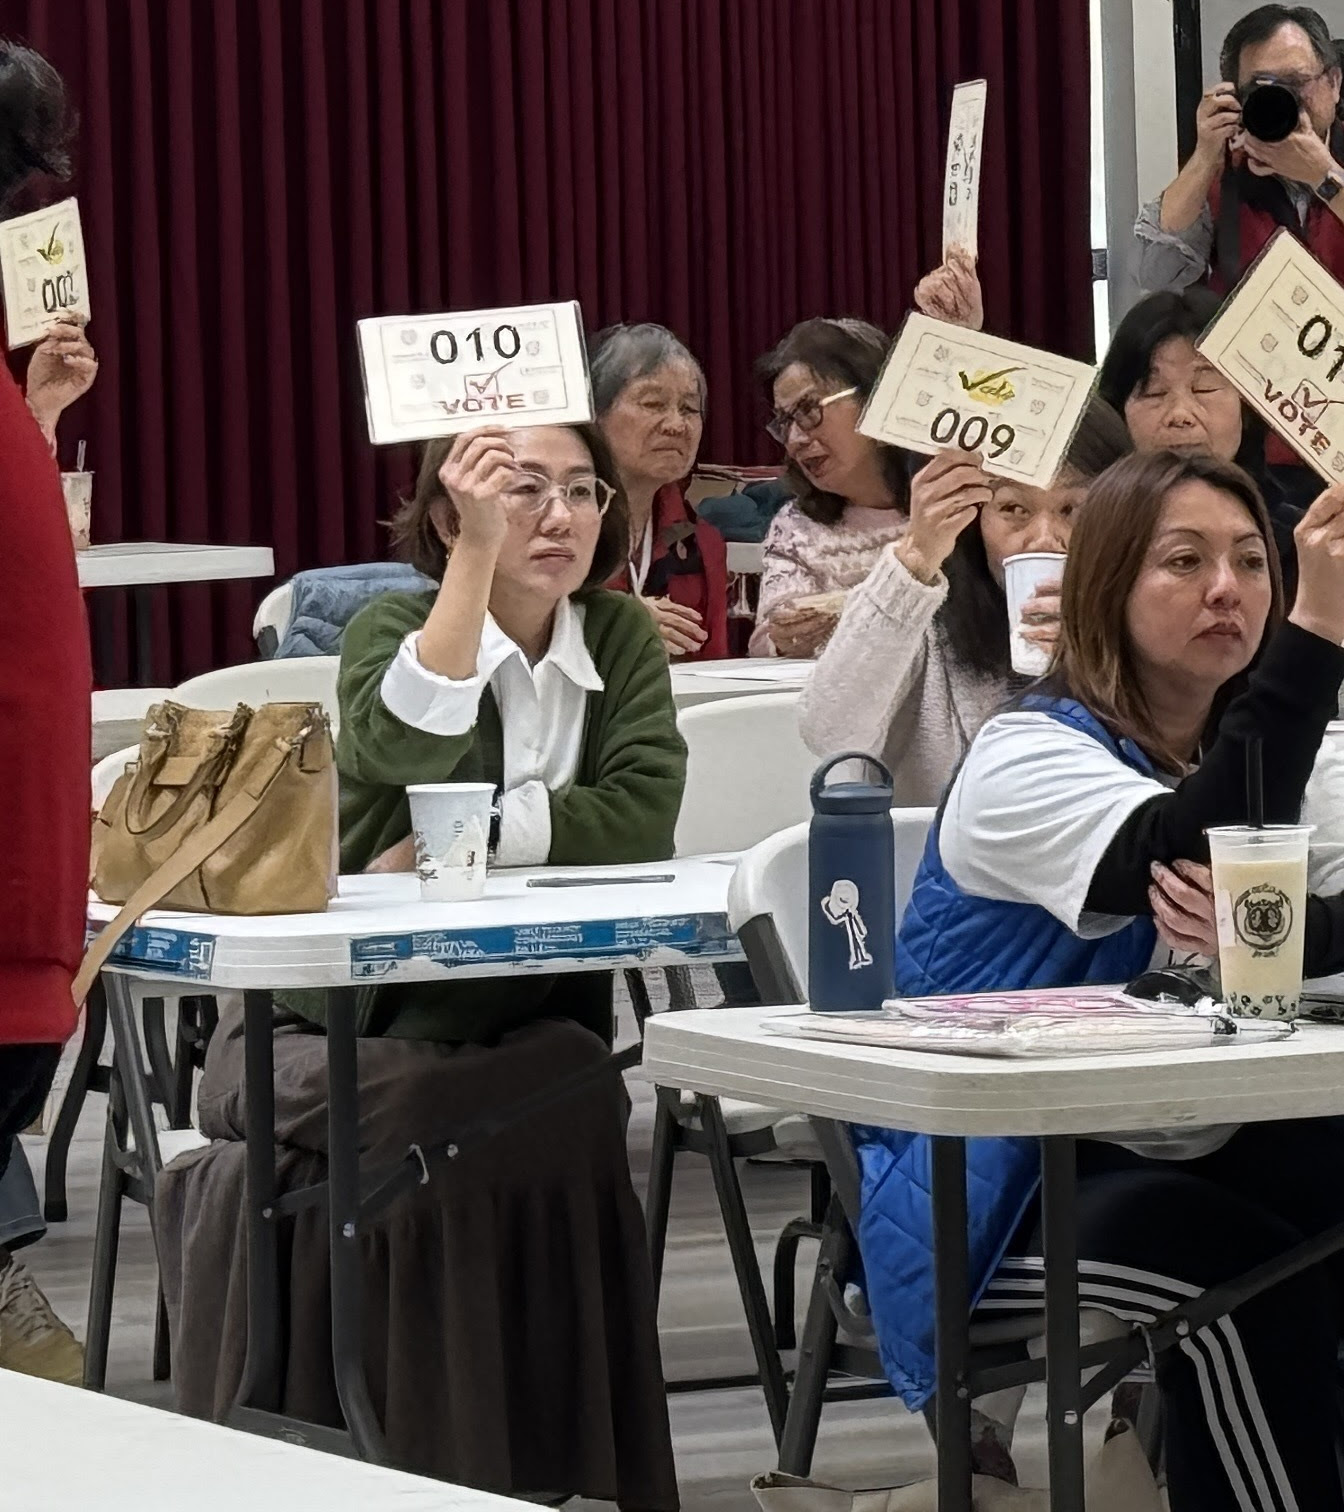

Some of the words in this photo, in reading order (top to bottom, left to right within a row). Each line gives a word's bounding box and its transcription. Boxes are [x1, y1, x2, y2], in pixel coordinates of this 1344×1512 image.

[430, 324, 521, 365] 010
[433, 393, 527, 415] VOTE
[1262, 378, 1332, 457] VOTE
[930, 407, 1016, 460] 009
